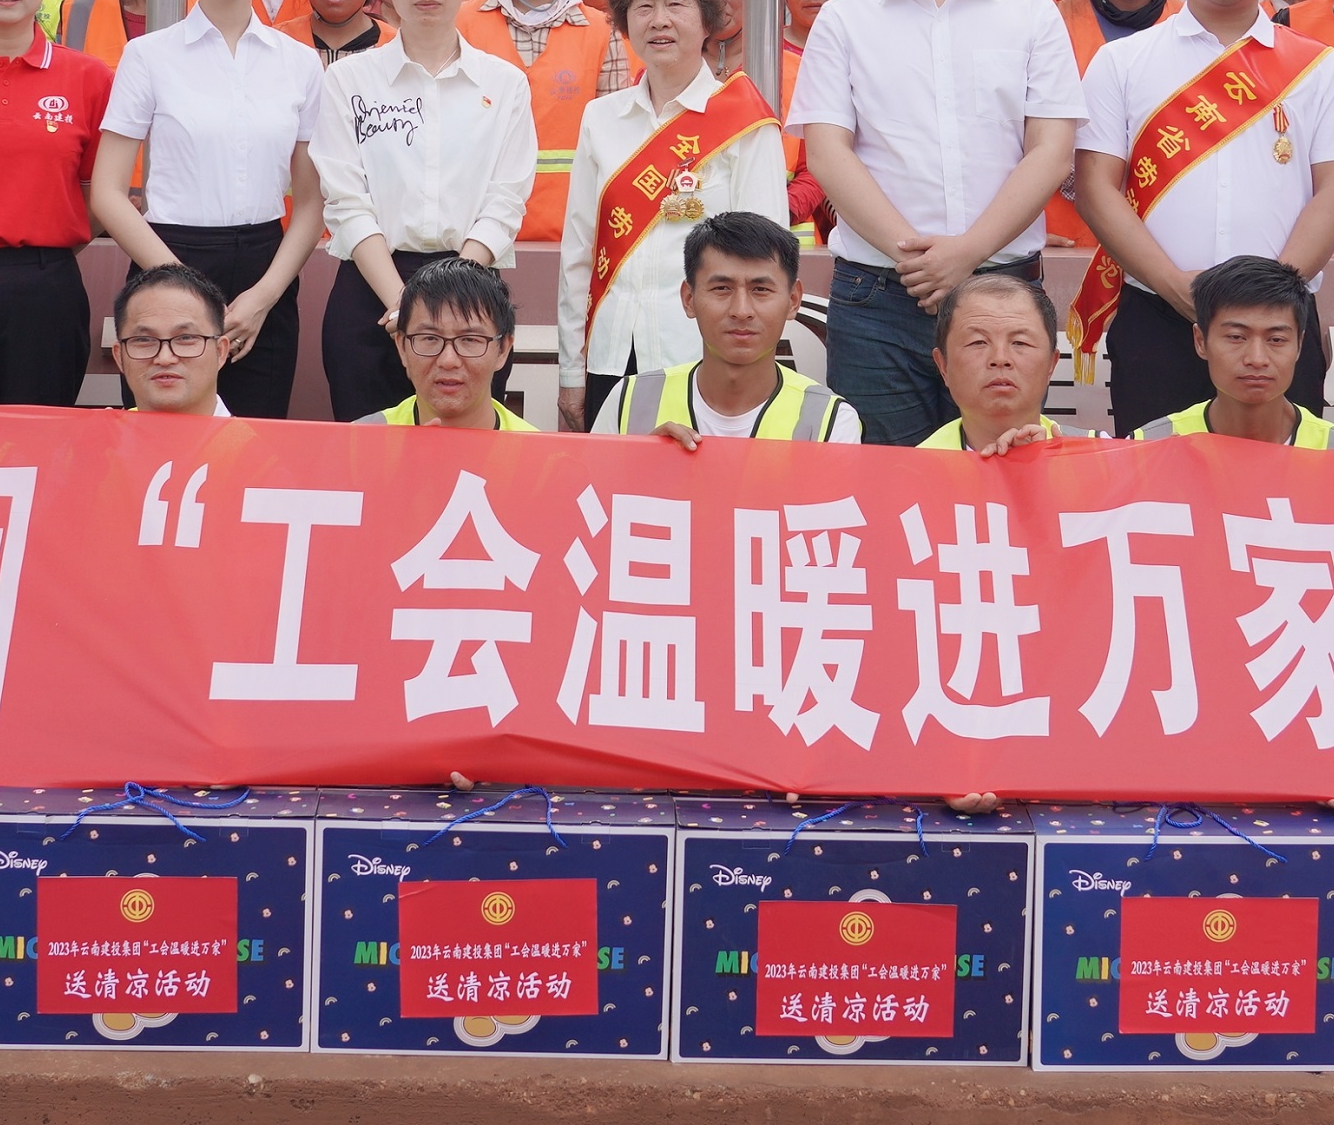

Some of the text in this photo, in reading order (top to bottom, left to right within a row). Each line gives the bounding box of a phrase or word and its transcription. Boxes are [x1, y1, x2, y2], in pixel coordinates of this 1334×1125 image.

[32, 111, 74, 125] 云南建投
[64, 970, 211, 1002] 送清凉活动
[427, 970, 572, 1002] 送清凉活动
[779, 993, 930, 1024] 送清凉活动
[1145, 989, 1290, 1019] 送清凉活动
